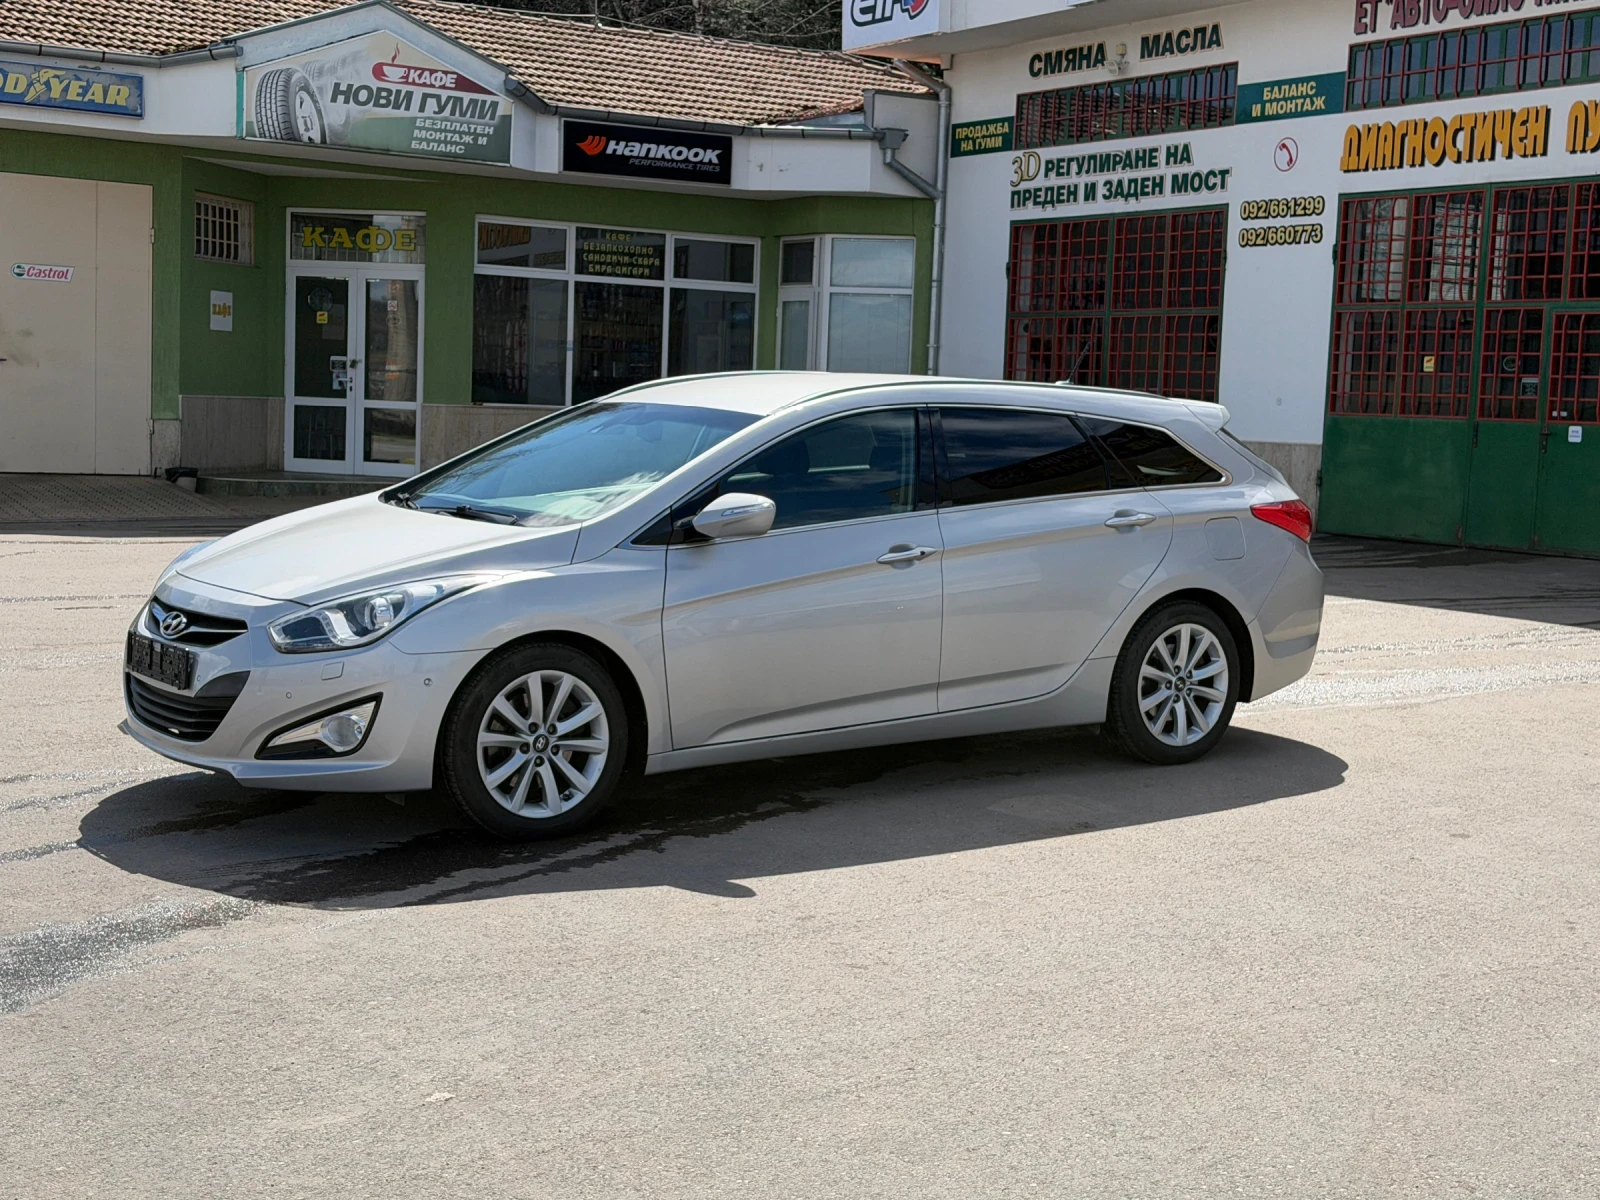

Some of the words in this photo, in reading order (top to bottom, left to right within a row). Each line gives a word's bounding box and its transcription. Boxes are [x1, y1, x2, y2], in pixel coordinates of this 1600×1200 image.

[1029, 41, 1108, 78] СМЯНА
[1139, 21, 1223, 62] МАСЛА
[408, 69, 458, 88] КАФЕ
[1263, 81, 1317, 101] БАЛАНС
[330, 82, 414, 111] НОВИ
[418, 92, 499, 121] ГУМИ
[1251, 103, 1261, 117] И
[1265, 96, 1326, 116] МОНТАЖ
[415, 119, 495, 135] БЕЗПЛАТЕН
[955, 121, 1009, 139] ПРОДАЖБА
[413, 129, 474, 144] МОНТАЖ
[478, 136, 488, 145] И
[961, 140, 974, 152] НА
[975, 136, 1003, 150] ГУМИ
[1340, 105, 1551, 172] ДИАГНОСТИЧЕН
[411, 141, 465, 154] БАЛАНС
[629, 158, 695, 170] PERFORMANCE
[696, 163, 721, 172] TIRES
[1010, 151, 1041, 187] 3D
[1043, 145, 1161, 179] РЕГУЛИРАНЕ
[1165, 142, 1193, 167] НА
[1010, 184, 1080, 211] ПРЕДЕН
[1083, 180, 1098, 204] И
[1101, 175, 1165, 205] ЗАДЕН
[1170, 167, 1232, 195] МОСТ
[1240, 196, 1325, 220] 092/661299
[302, 225, 417, 253] КАФЕ
[605, 232, 632, 242] КАФЕ
[1238, 223, 1323, 248] 092/660773
[27, 266, 70, 280] Castrol
[588, 264, 612, 273] БИРА
